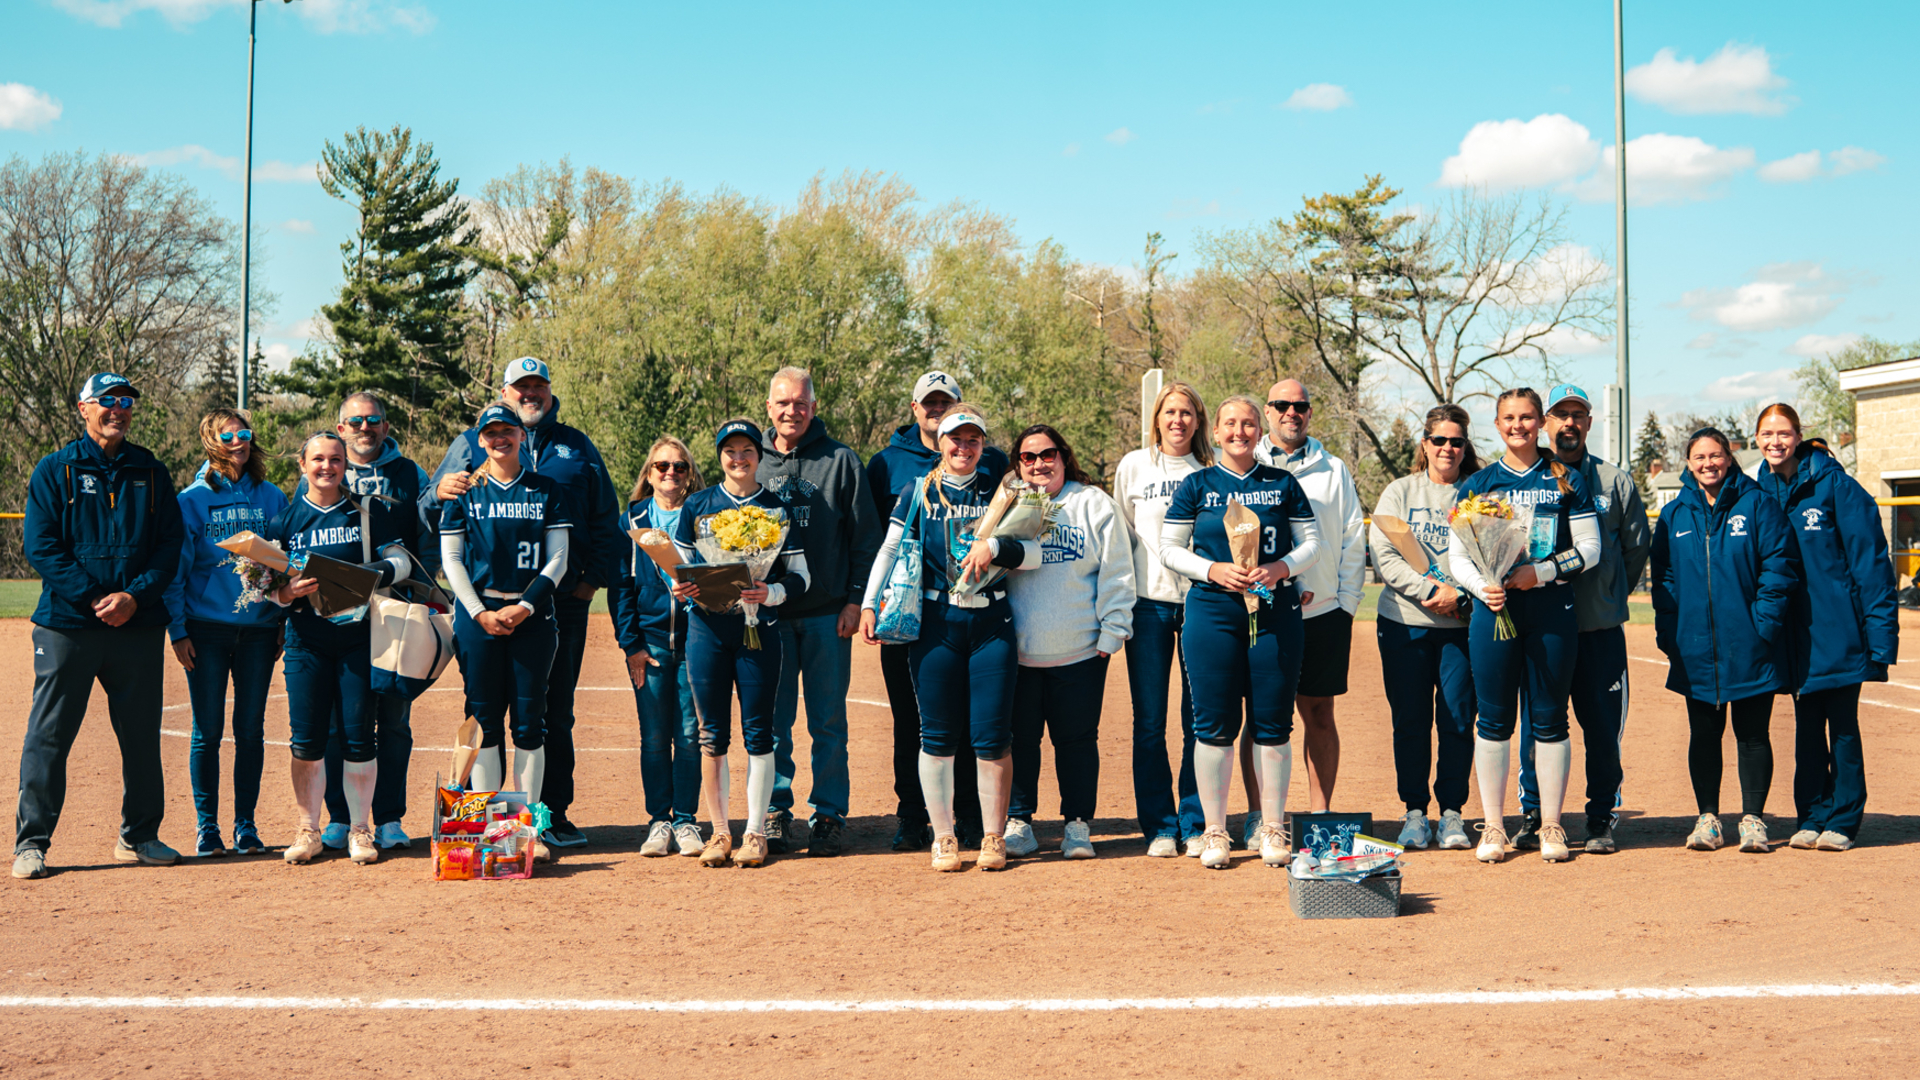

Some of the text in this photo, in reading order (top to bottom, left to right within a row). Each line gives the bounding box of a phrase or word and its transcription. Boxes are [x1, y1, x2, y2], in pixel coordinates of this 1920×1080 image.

[1143, 483, 1158, 501] ST.
[1204, 489, 1282, 508] ST. AMBROSE
[212, 510, 225, 522] ST.
[469, 502, 543, 520] ST. AMBROSE
[251, 520, 269, 535] BEE
[1263, 525, 1277, 555] 3
[1416, 534, 1449, 545] SOFTB
[517, 541, 540, 569] 21
